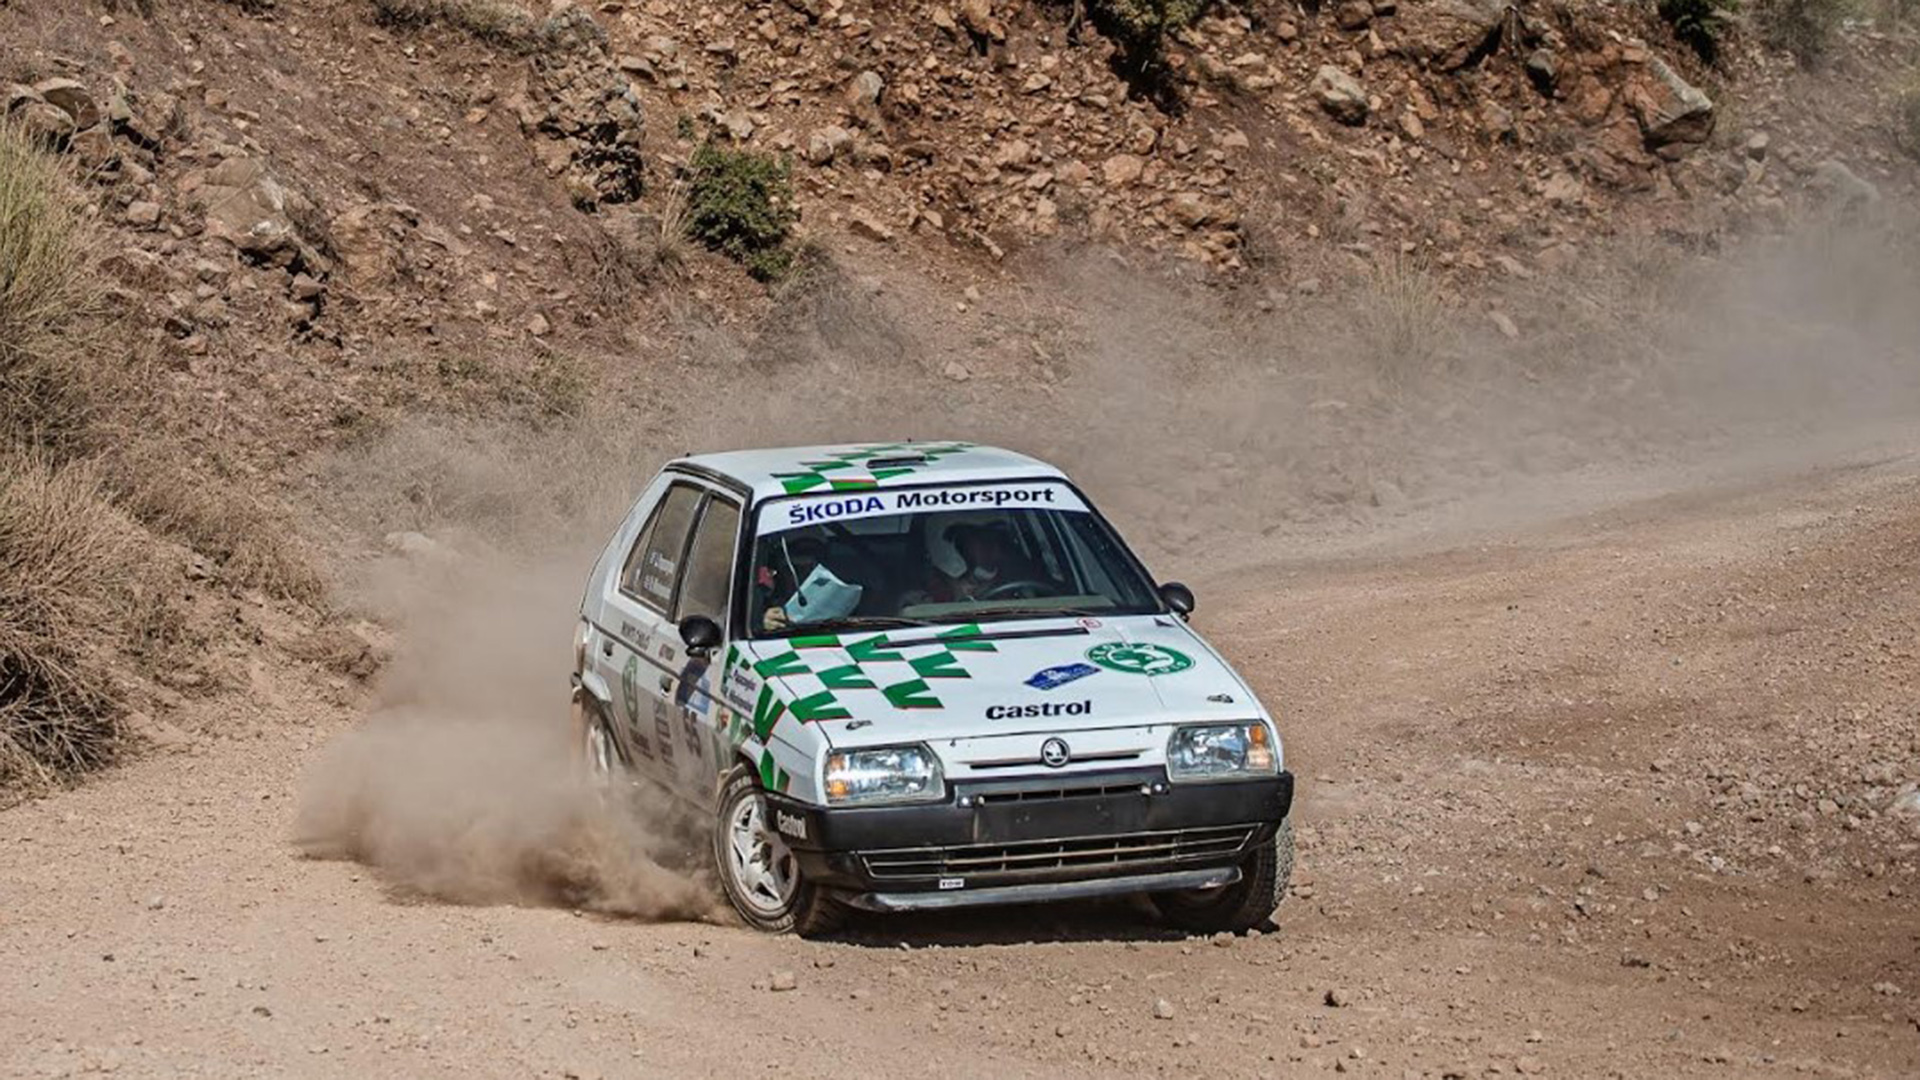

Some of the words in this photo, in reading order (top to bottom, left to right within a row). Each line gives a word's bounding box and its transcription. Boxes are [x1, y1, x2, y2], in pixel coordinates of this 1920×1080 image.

[788, 496, 885, 525] ŠKODA
[896, 487, 1054, 509] Motorsport
[777, 809, 807, 840] Castrol
